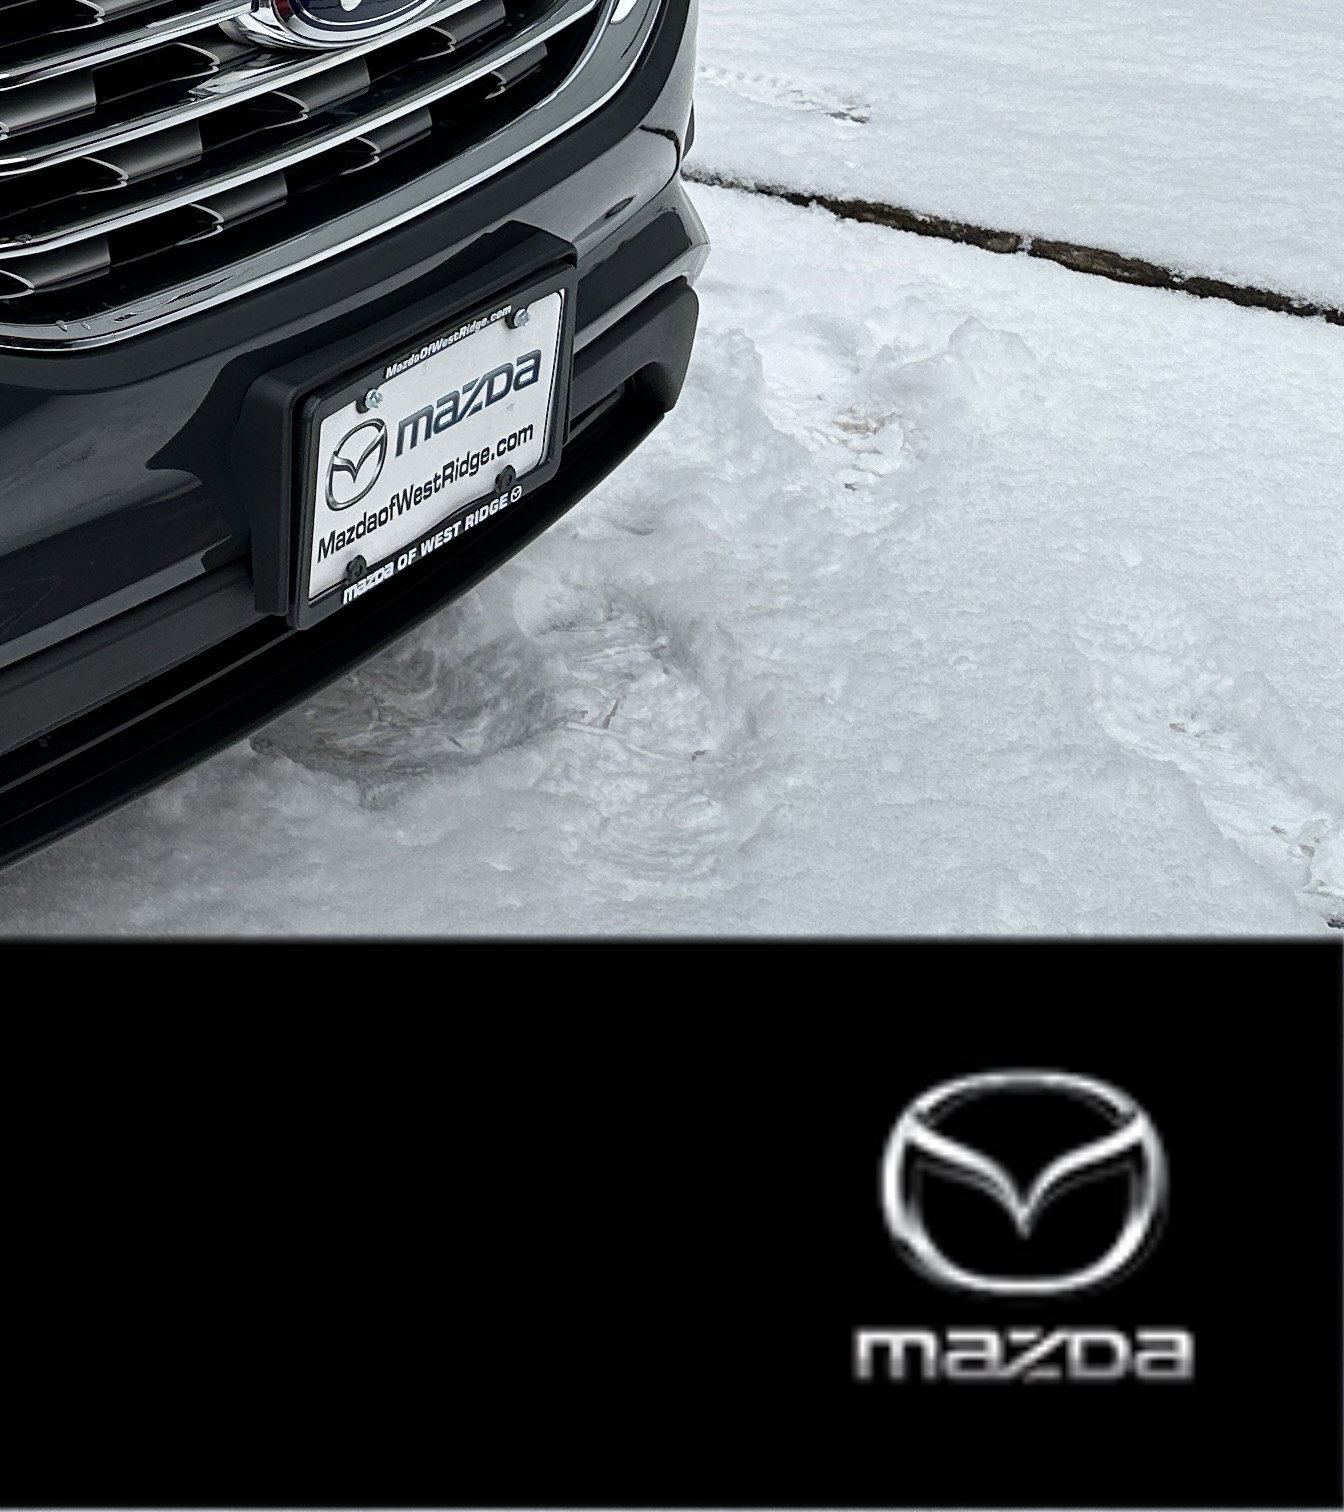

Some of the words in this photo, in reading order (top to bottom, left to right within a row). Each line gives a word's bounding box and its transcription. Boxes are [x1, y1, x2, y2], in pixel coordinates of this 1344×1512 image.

[385, 305, 512, 379] MazdaOfWestRidge.com
[317, 424, 534, 563] MazdaofWestRidge.com
[397, 548, 417, 571] OF
[420, 520, 462, 557] WEST
[464, 492, 509, 531] RIDGE
